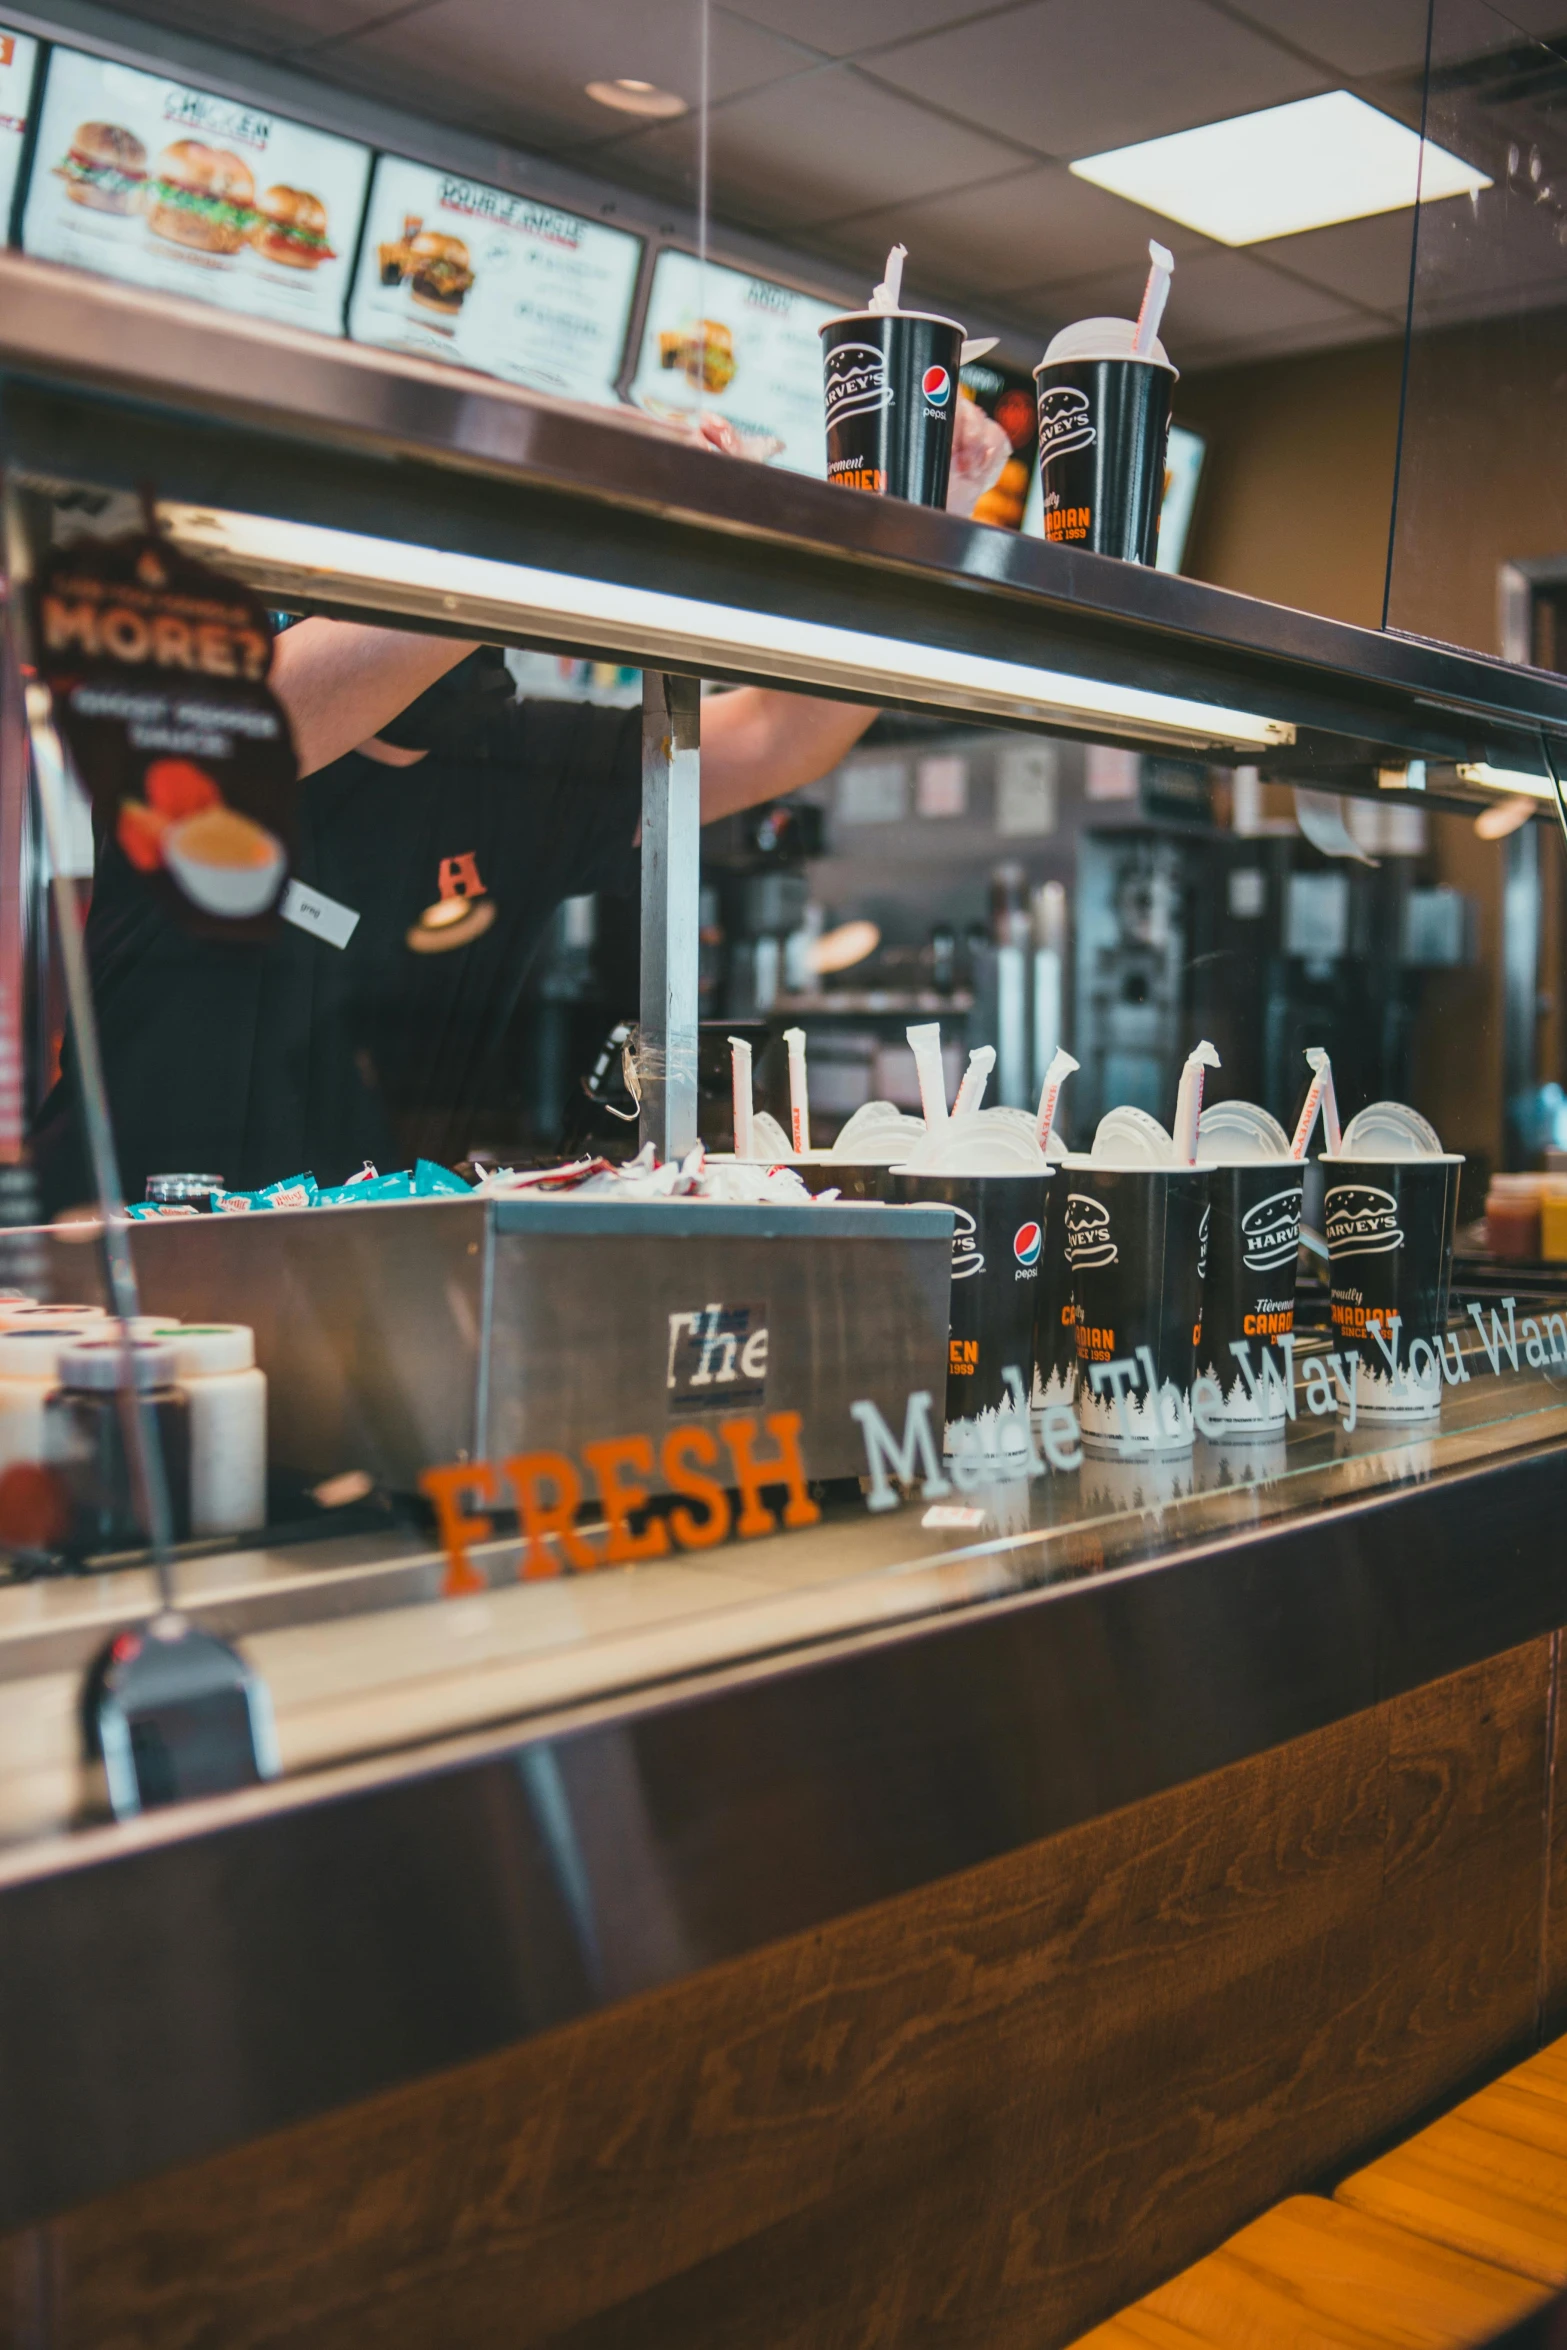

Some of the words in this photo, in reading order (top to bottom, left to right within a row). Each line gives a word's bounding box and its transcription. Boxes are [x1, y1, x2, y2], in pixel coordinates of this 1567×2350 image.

[922, 406, 947, 421] pepsi
[1065, 528, 1087, 540] 1959
[43, 598, 271, 681] MORE?
[1014, 1265, 1039, 1281] pepsi
[1341, 1326, 1368, 1338] SINCE
[666, 1302, 769, 1389] The
[419, 1410, 821, 1597] FRESH
[850, 1364, 1085, 1512] Made
[1088, 1345, 1227, 1456] The
[1228, 1332, 1360, 1433] Way
[1365, 1315, 1471, 1397] You
